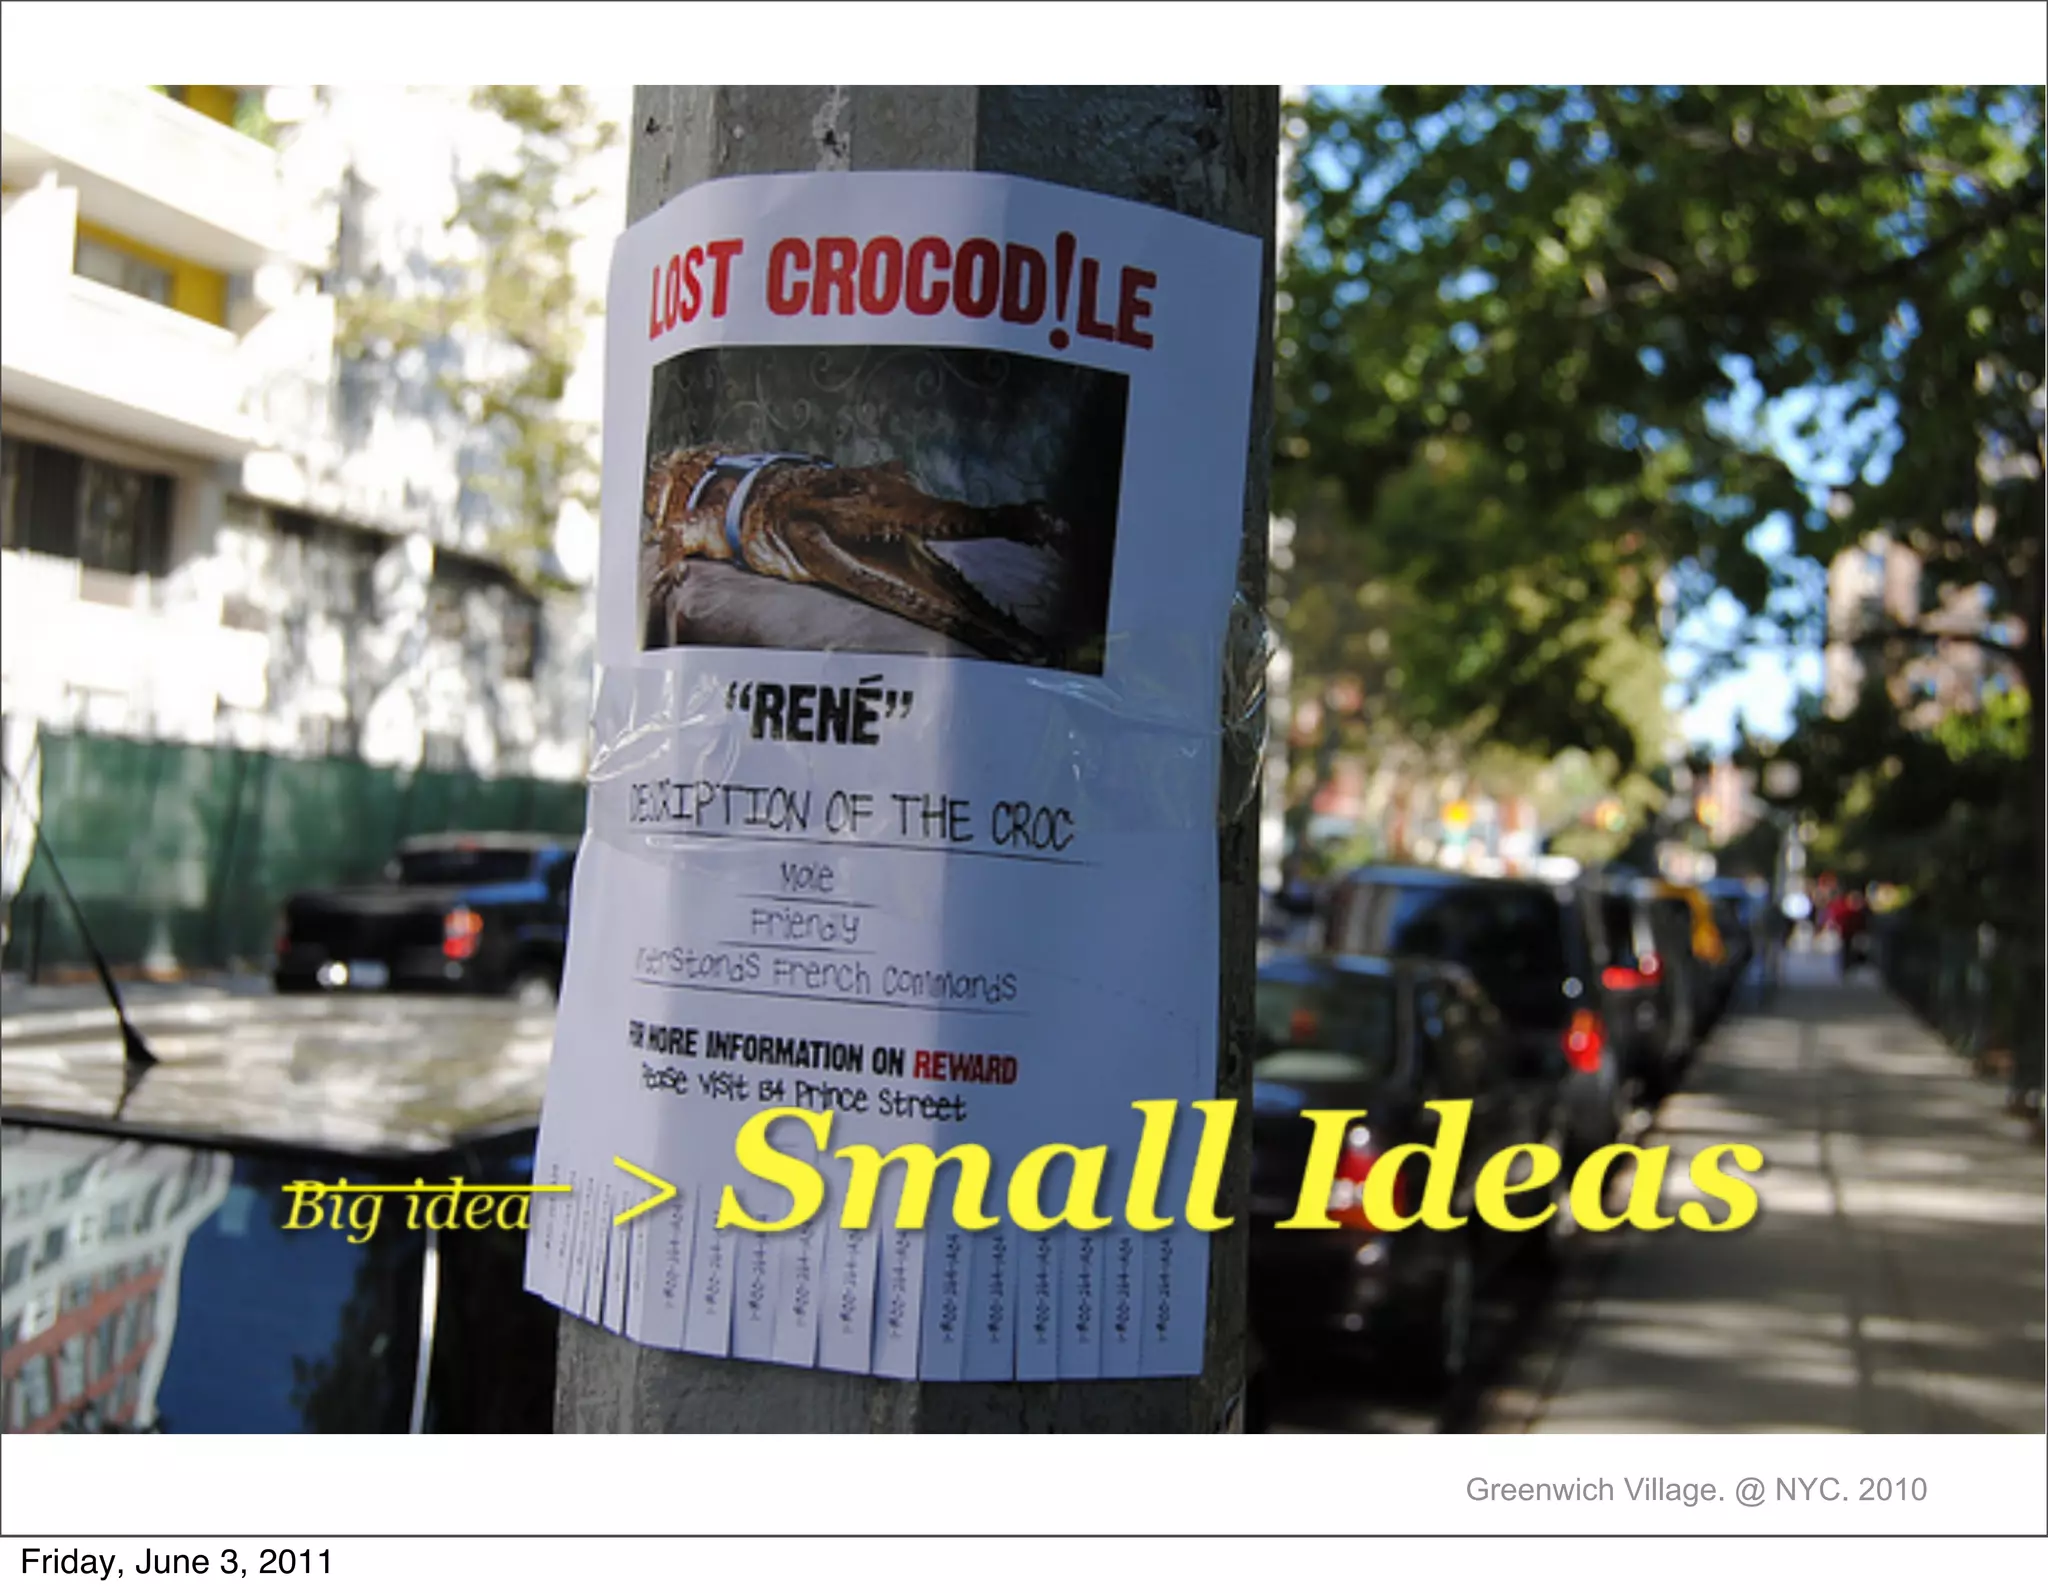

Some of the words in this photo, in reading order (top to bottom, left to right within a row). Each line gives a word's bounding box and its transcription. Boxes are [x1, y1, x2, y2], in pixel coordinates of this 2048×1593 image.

[648, 237, 744, 342] LOST
[825, 788, 874, 833] OF
[890, 793, 975, 843] THE
[992, 800, 1076, 851] CROC
[751, 907, 860, 945] Friendly
[772, 958, 871, 995] French
[881, 963, 1018, 1004] Commands
[647, 1024, 699, 1059] MORE
[705, 1029, 865, 1075] INFORMATION
[872, 1046, 905, 1078] ON
[912, 1049, 1019, 1086] REWARD
[795, 1077, 868, 1113] Prince
[878, 1087, 968, 1123] Street
